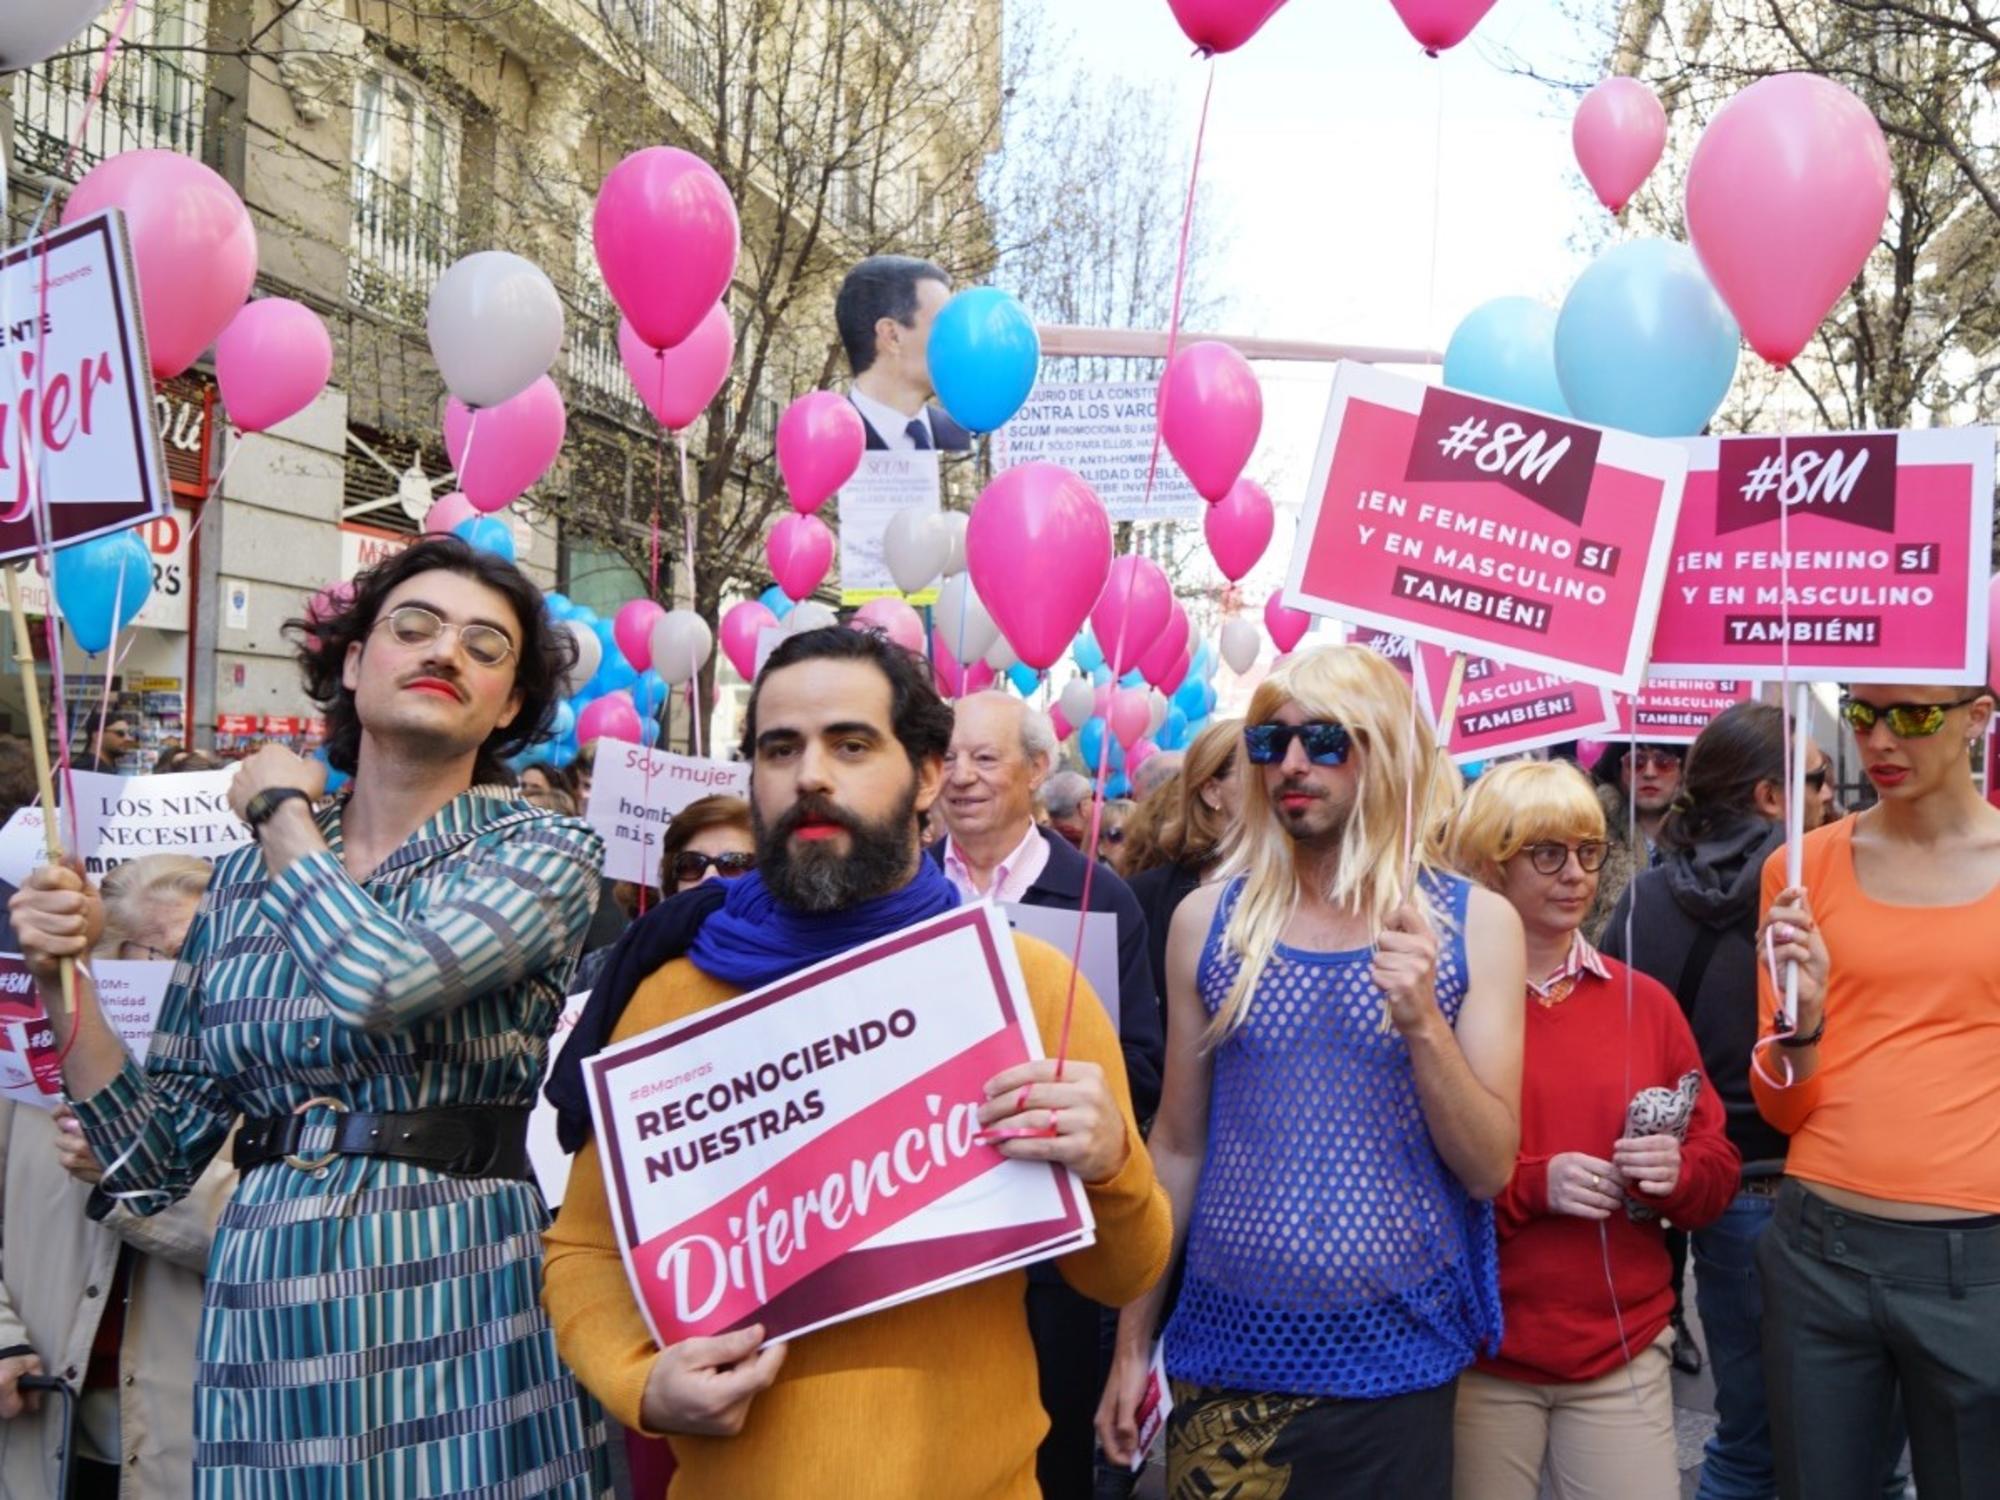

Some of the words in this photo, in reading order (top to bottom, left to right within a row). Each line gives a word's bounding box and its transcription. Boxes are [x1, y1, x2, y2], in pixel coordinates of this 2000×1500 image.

[1069, 388, 1085, 401] DE
[1088, 388, 1104, 401] LA
[1107, 386, 1160, 401] CONSTIT
[1011, 405, 1074, 421] ONTRA
[1078, 403, 1110, 419] LOS
[1113, 402, 1158, 419] VARO
[1008, 425, 1051, 438] SCUM
[1438, 415, 1571, 485] #8M
[1122, 480, 1192, 493] INVESTIGA
[1740, 448, 1869, 505] #8M
[1356, 488, 1407, 518] ¡EN
[1417, 504, 1571, 559] FEMENINO
[1581, 545, 1613, 571] SÍ
[1357, 525, 1376, 545] Y
[1384, 533, 1422, 559] EN
[1433, 544, 1607, 606] MASCULINO
[1676, 552, 1723, 574] ¡EN
[1735, 550, 1889, 570] FEMENINO
[1900, 546, 1931, 570] SÍ
[1402, 574, 1547, 629] TAMBIÉN!
[1681, 587, 1698, 605] Y
[1708, 586, 1745, 606] EN
[1756, 586, 1933, 606] MASCULINO
[1731, 618, 1875, 642] TAMBIÉN!
[1648, 679, 1716, 691] EMENINO
[1463, 696, 1572, 732] TAMBIÉN!
[1650, 696, 1736, 709] MASCULINO
[625, 750, 664, 777] Soy
[670, 763, 737, 787] mujer
[101, 797, 151, 817] LOS
[162, 790, 231, 816] NIÑO
[618, 797, 676, 825] homb
[615, 824, 657, 845] mis
[31, 1029, 55, 1049] #8
[635, 1008, 918, 1142] RECONOCIENDO
[644, 1090, 826, 1184] NUESTRAS
[656, 1094, 985, 1324] Diferencia
